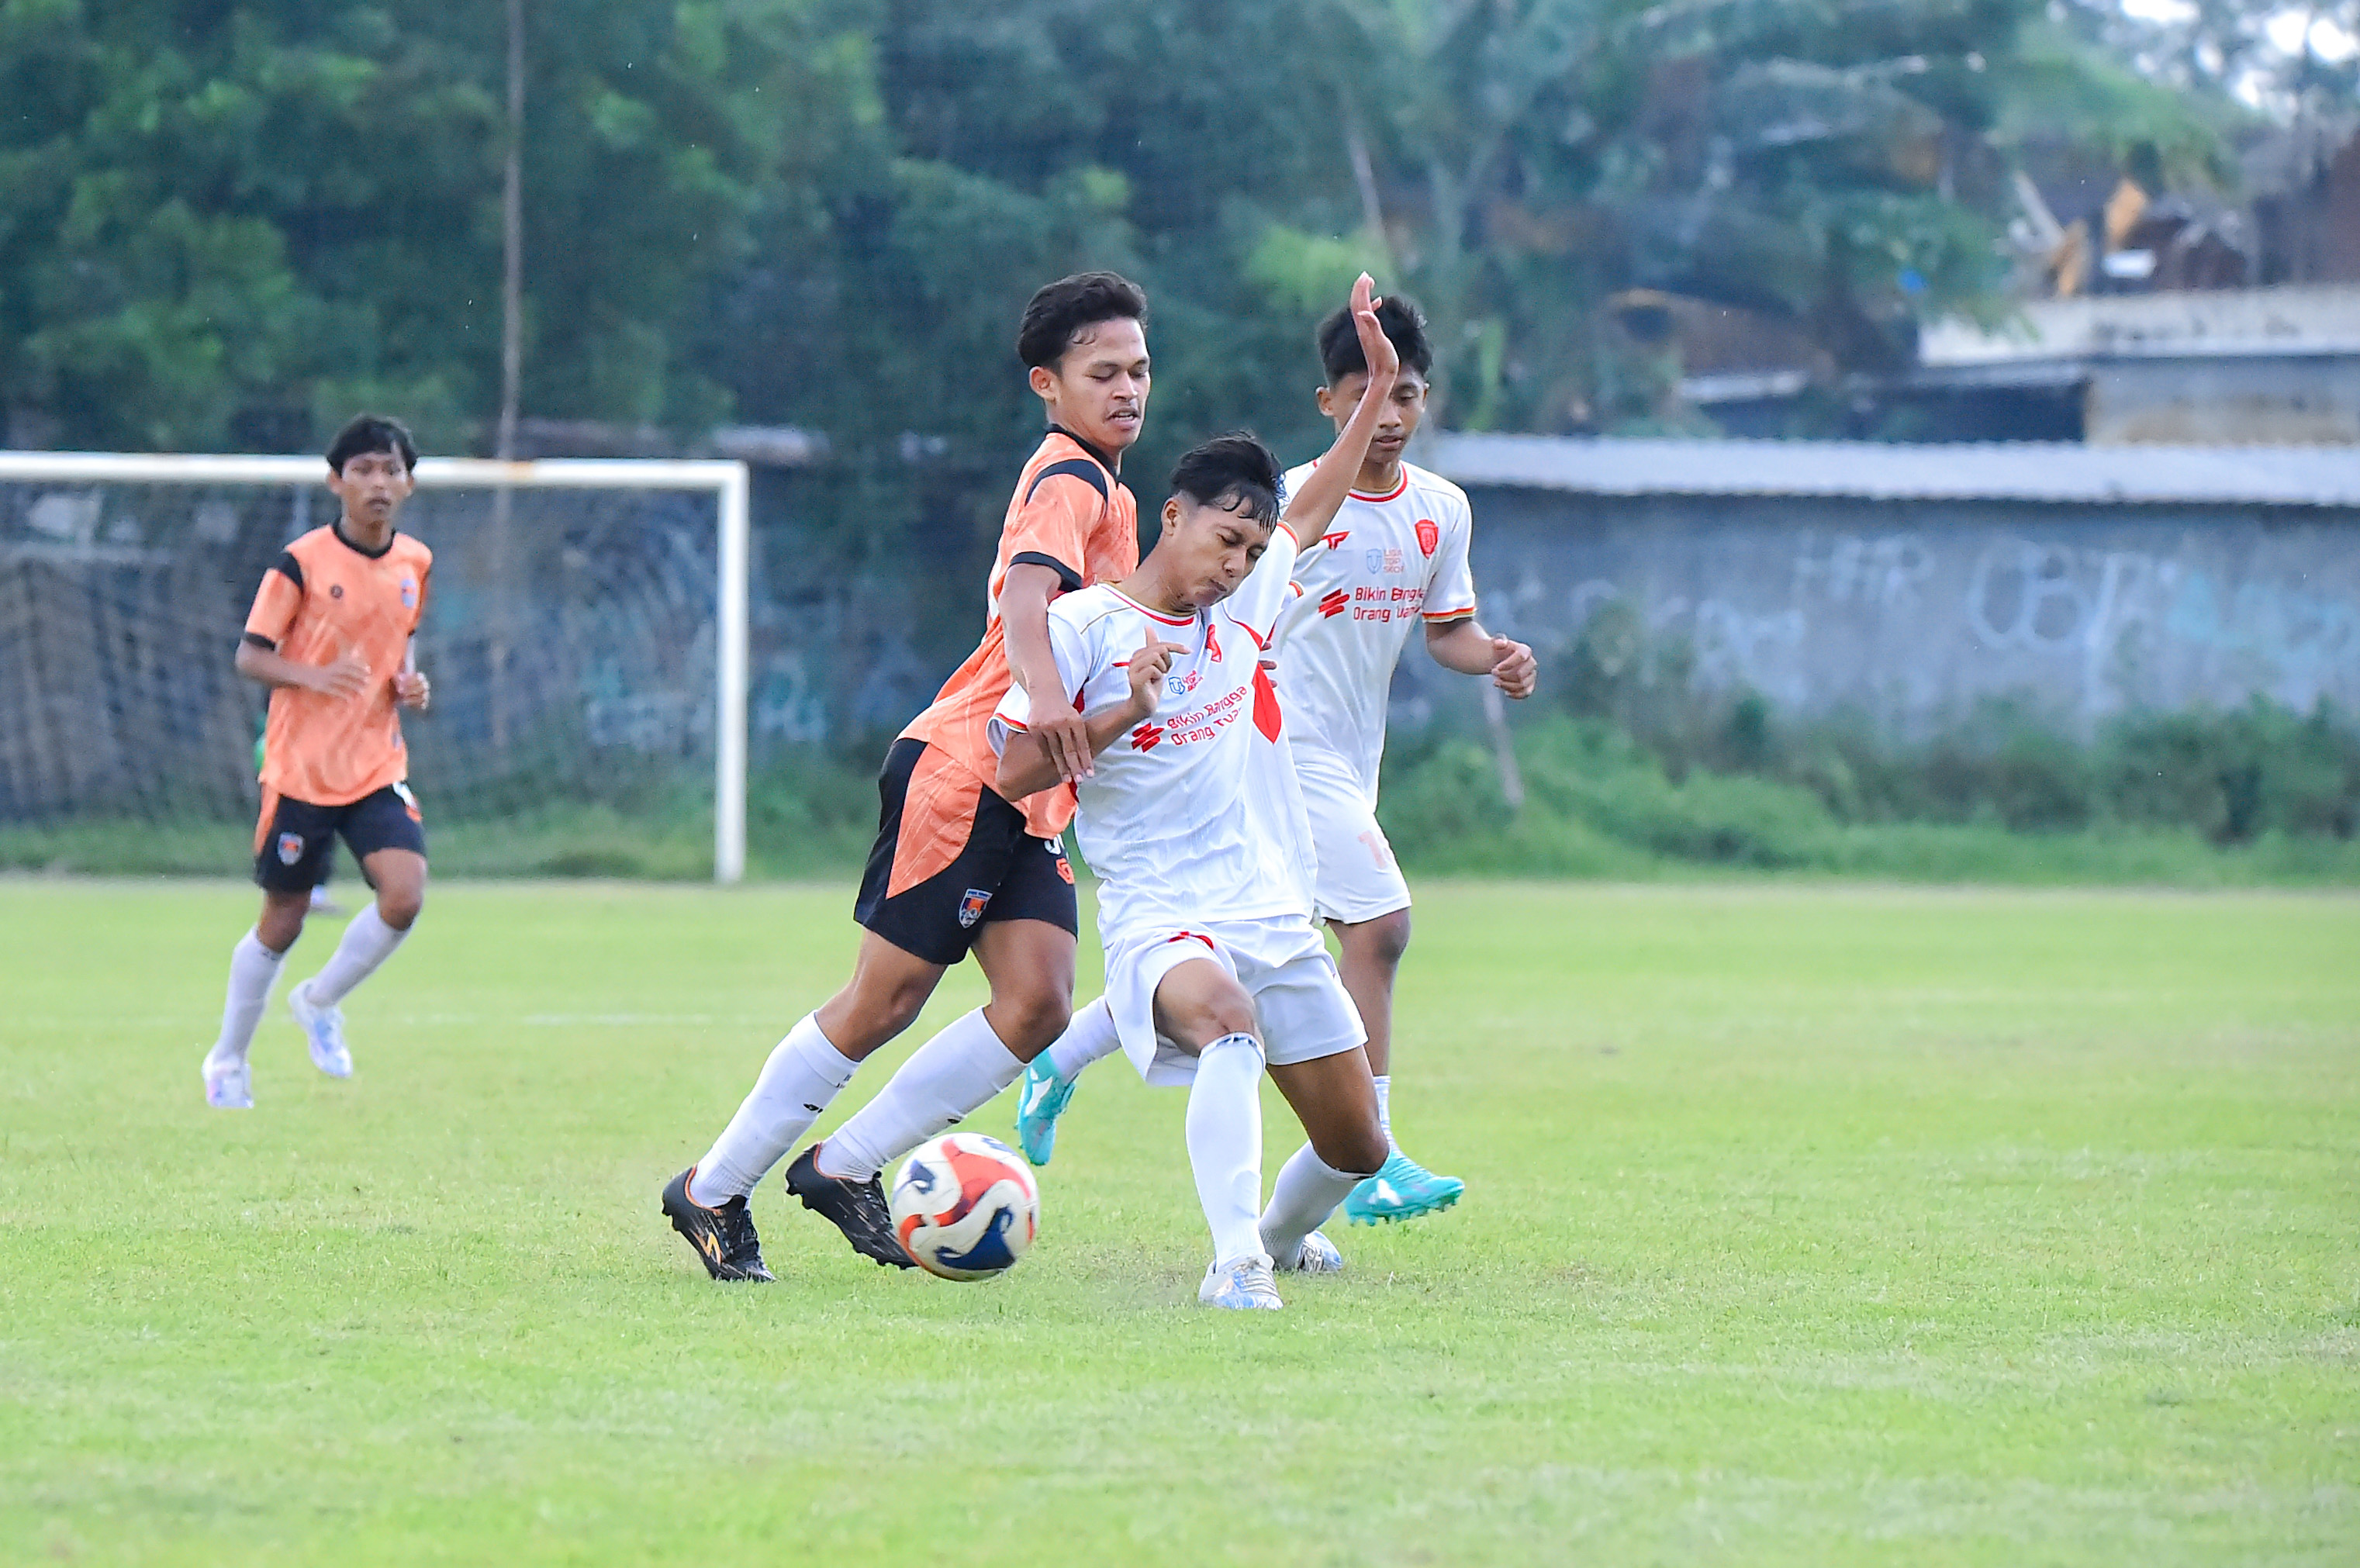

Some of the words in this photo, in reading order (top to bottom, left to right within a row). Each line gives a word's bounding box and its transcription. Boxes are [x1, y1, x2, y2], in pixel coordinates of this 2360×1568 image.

[1355, 587, 1387, 601] Bikin
[1353, 606, 1391, 623] Orang
[1167, 710, 1205, 729] Bikin
[1204, 686, 1247, 717] Bangga
[1171, 726, 1216, 745] Orang
